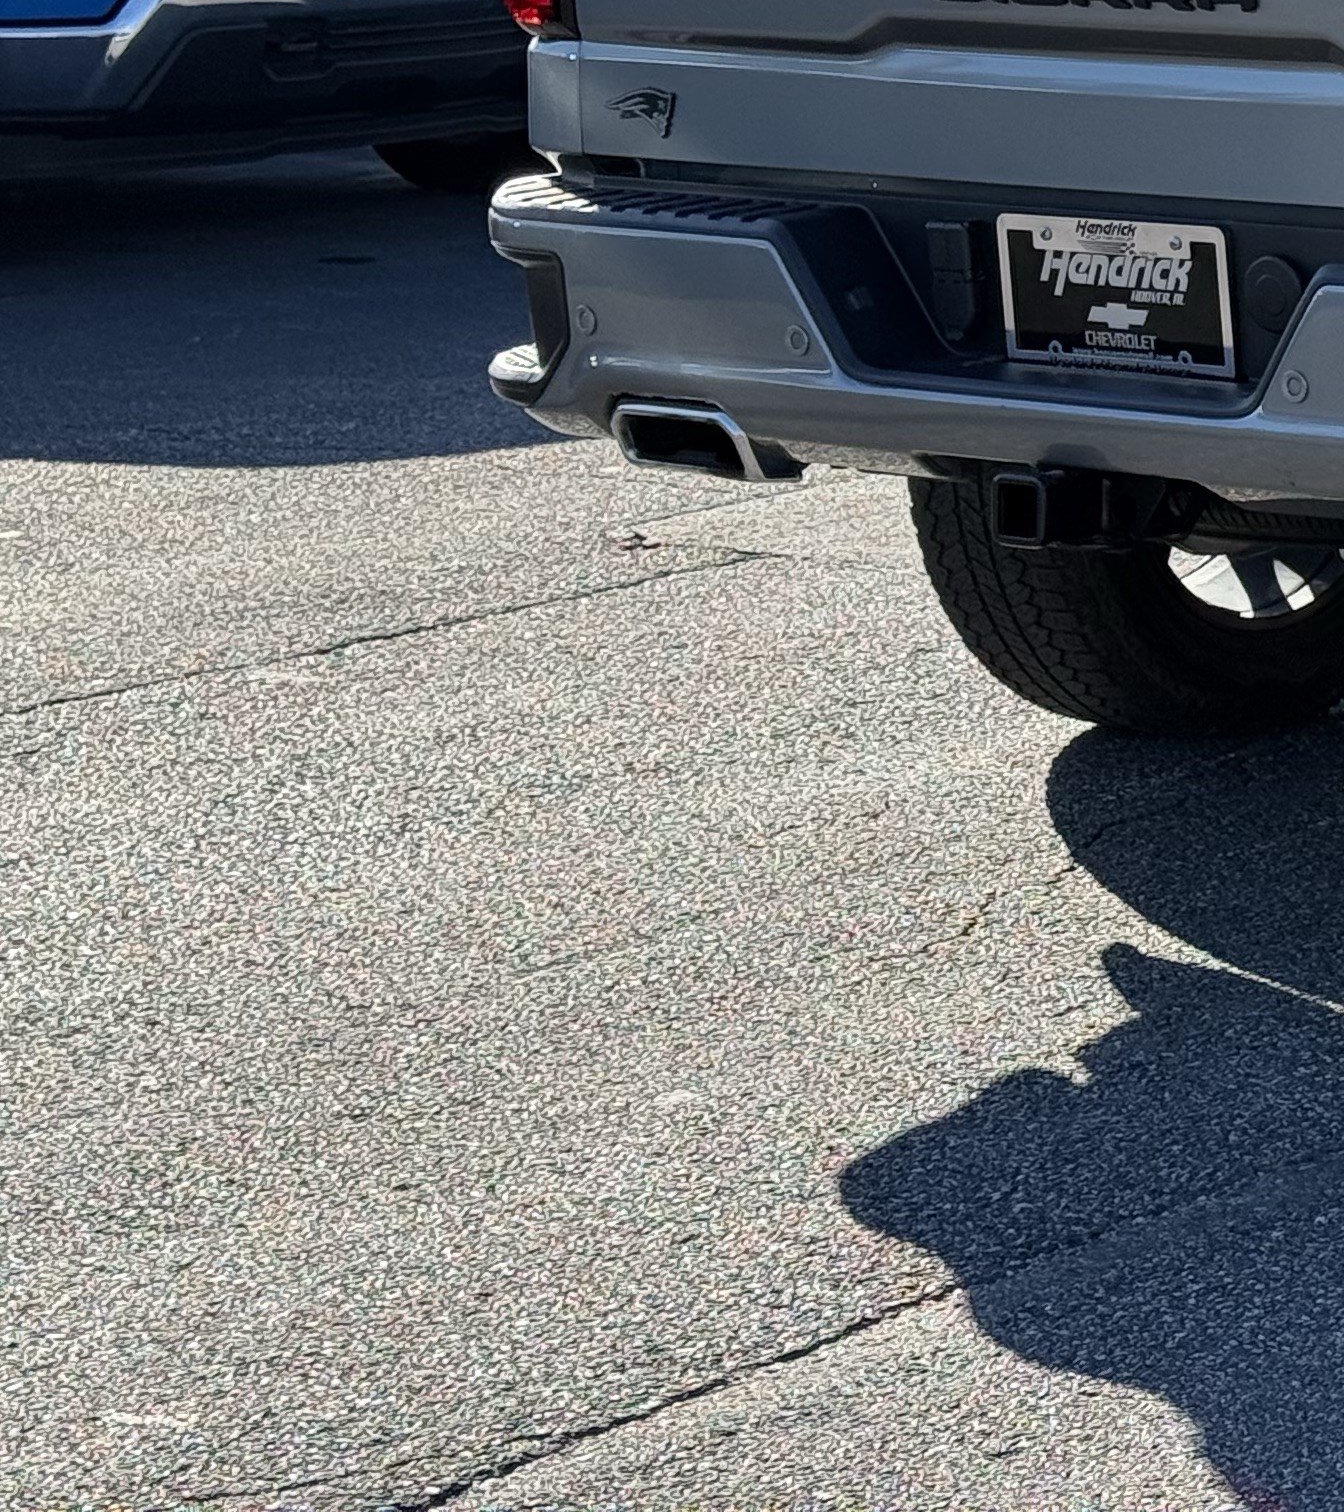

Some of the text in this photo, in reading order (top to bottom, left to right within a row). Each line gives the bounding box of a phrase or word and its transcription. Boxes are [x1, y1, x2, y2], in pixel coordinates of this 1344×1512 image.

[1075, 219, 1138, 239] Hendrick
[1039, 250, 1193, 297] Hendrick
[1084, 329, 1157, 351] CHEVROLET
